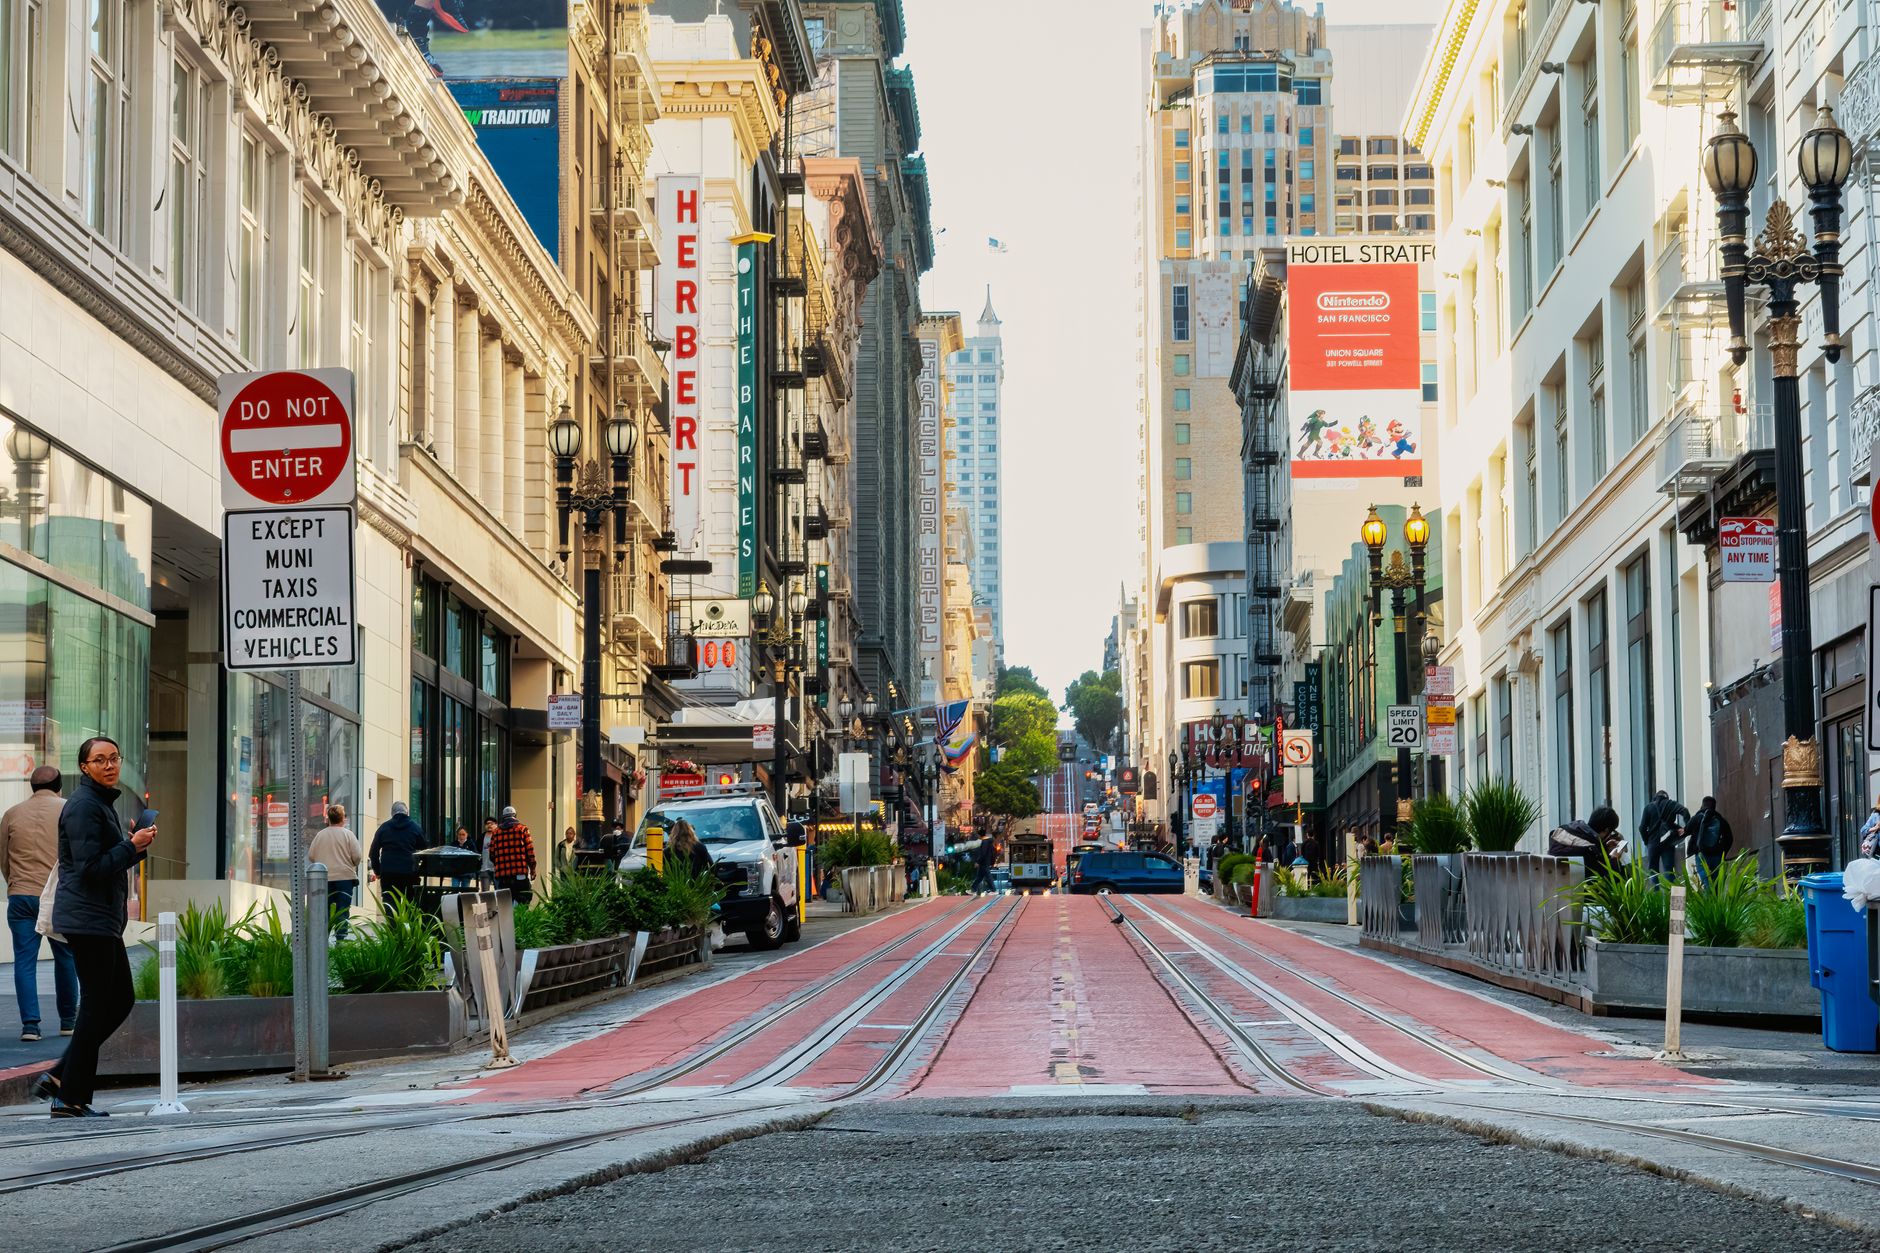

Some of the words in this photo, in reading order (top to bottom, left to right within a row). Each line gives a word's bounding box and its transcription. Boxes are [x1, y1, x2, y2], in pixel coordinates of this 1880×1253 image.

[1291, 245, 1354, 263] HOTEL
[1323, 296, 1385, 307] Nintendo
[740, 287, 751, 365] THE
[1317, 315, 1336, 323] SAN
[1338, 314, 1391, 323] FRANCISCO
[675, 189, 698, 496] HERBERT
[1325, 349, 1352, 357] UNION
[1353, 348, 1384, 357] SQUARE
[240, 400, 270, 421] DO
[286, 397, 330, 418] NOT
[919, 341, 937, 534] CHANCELLOR
[251, 456, 323, 480] ENTER
[740, 385, 752, 558] BARNES
[251, 518, 325, 540] EXCEPT
[1722, 536, 1738, 545] NO
[1740, 536, 1773, 546] STOPPING
[266, 548, 313, 569] MUNI
[1727, 552, 1745, 563] ANY
[1748, 552, 1770, 563] TIME
[262, 577, 317, 599] TAXIS
[919, 547, 938, 644] HOTEL
[234, 606, 347, 629] COMMERCIAL
[244, 635, 338, 658] VEHICLES
[1308, 668, 1318, 702] WINE
[1298, 686, 1306, 730] COCKTA
[1276, 716, 1284, 776] COCKTAILS
[1391, 727, 1418, 743] 20
